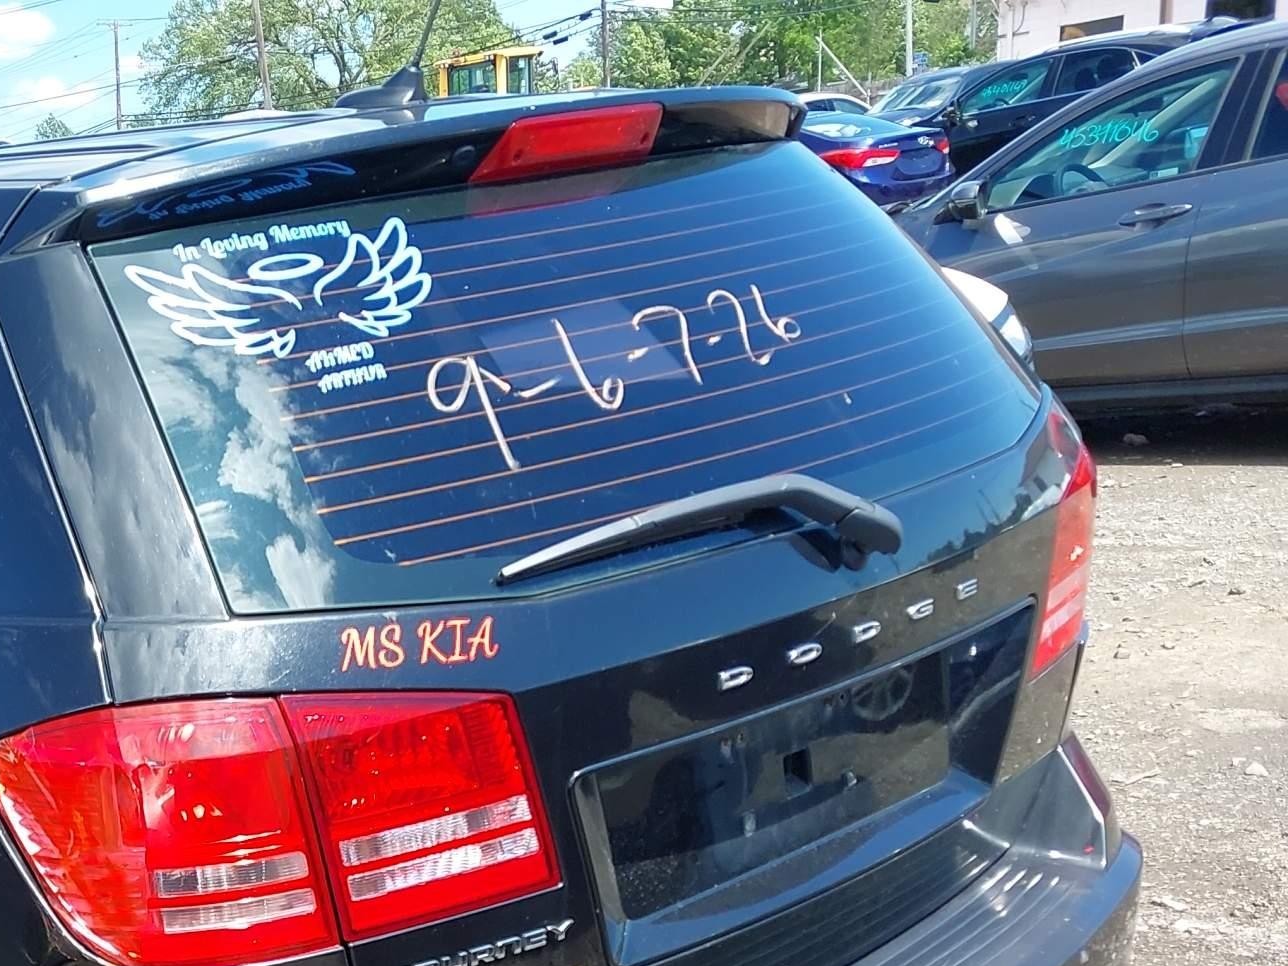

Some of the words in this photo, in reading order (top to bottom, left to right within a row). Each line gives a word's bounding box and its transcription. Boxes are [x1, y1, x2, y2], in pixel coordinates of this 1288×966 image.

[173, 243, 201, 262] In
[201, 232, 268, 260] Loving
[269, 220, 351, 244] Memory
[341, 623, 405, 673] MS
[417, 615, 500, 665] KIA
[718, 578, 978, 691] DODGE
